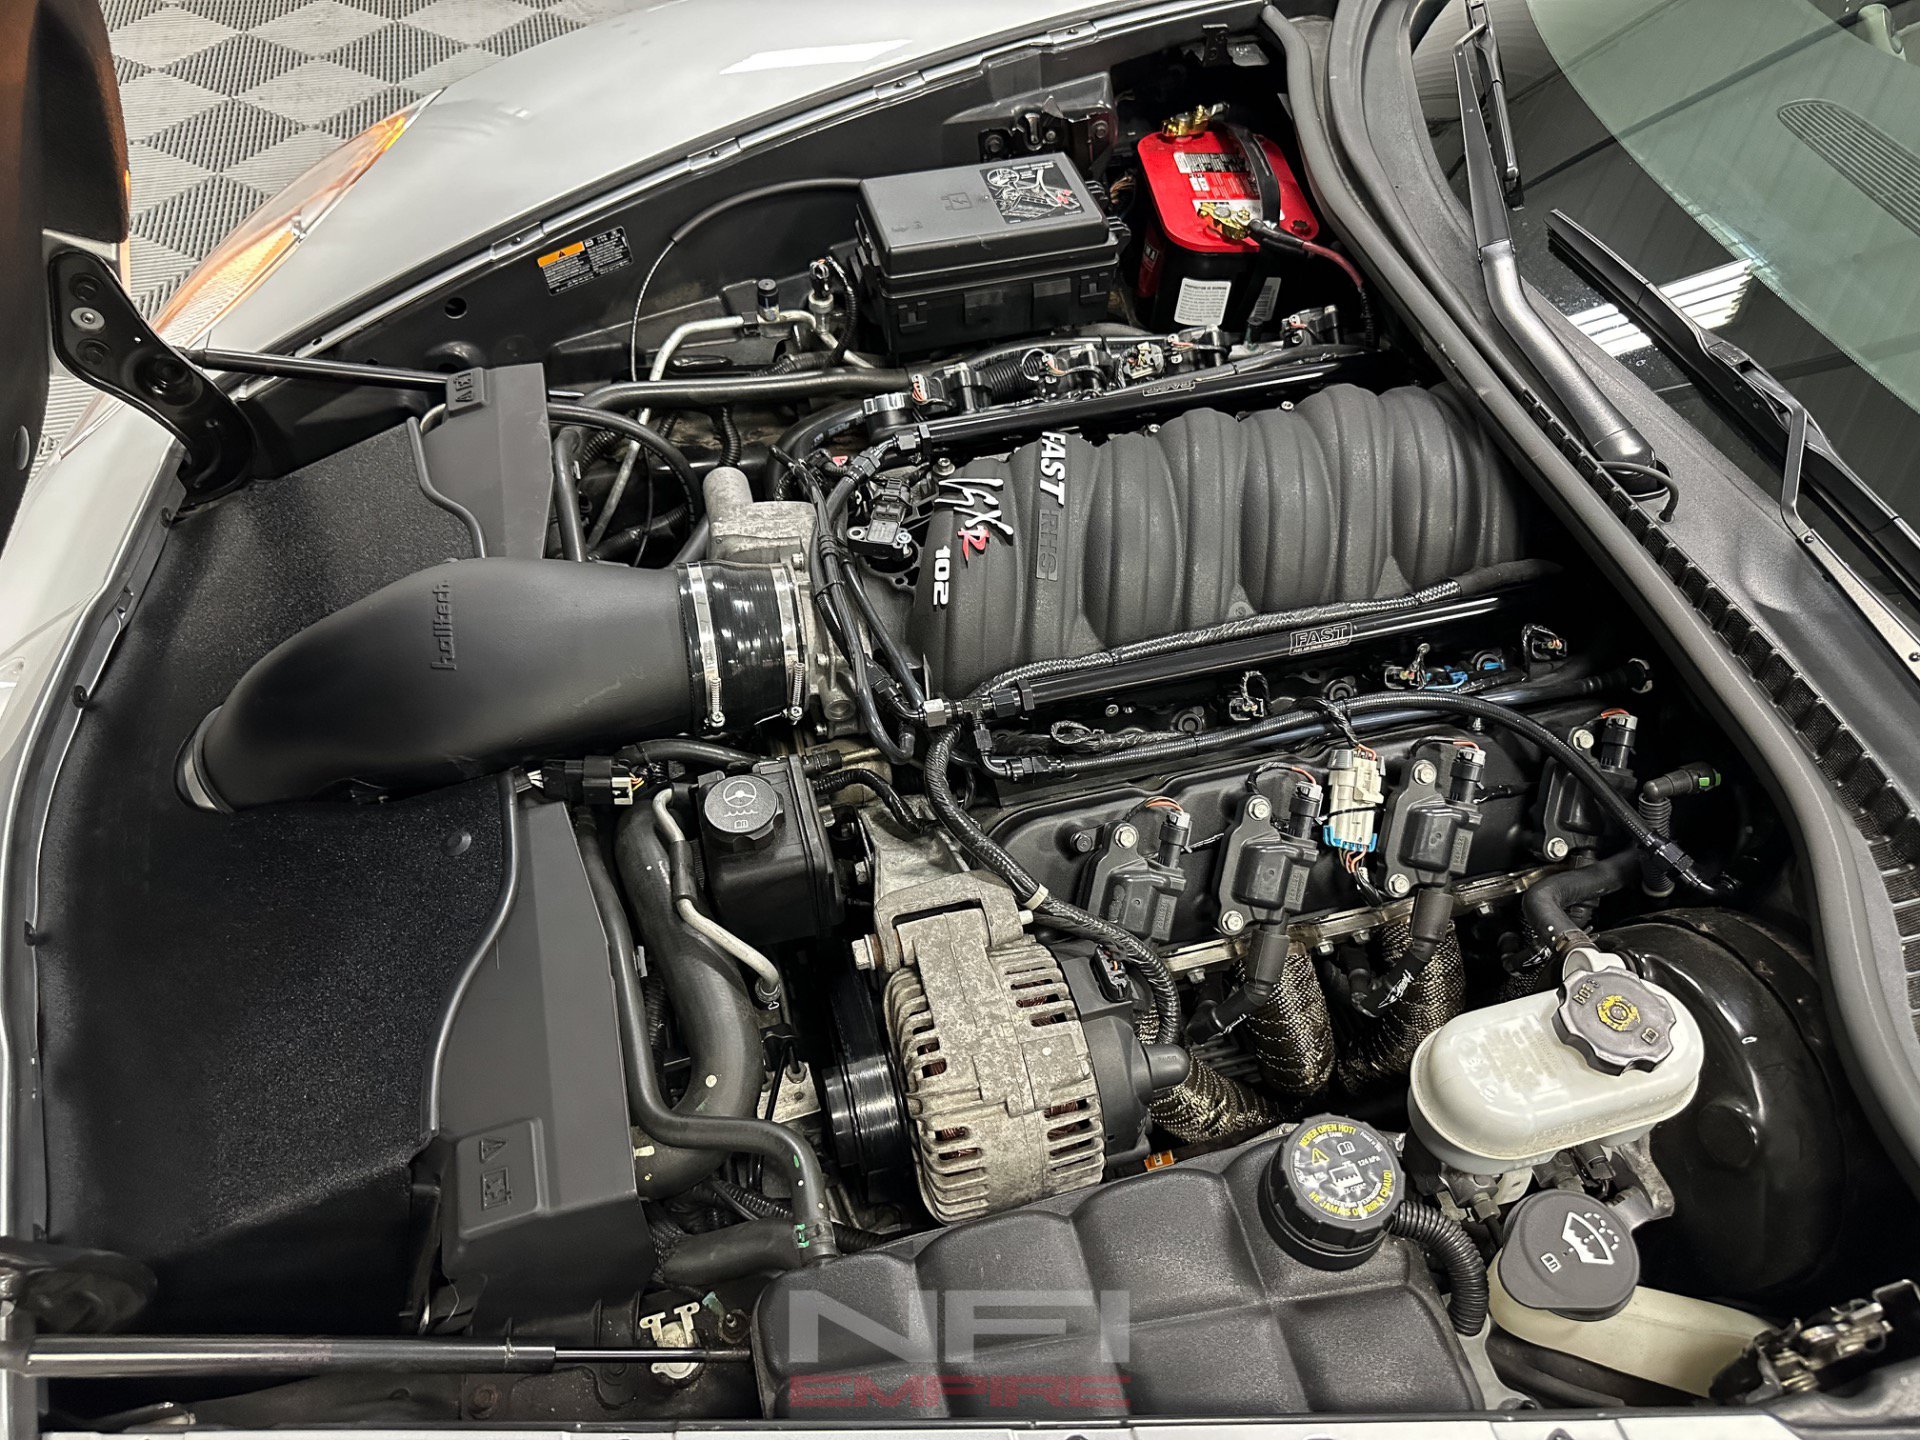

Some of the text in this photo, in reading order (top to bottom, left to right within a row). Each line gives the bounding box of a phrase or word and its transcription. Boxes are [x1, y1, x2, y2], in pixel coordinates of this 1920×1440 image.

[1040, 431, 1066, 506] FAST
[1038, 509, 1060, 580] RHS
[933, 545, 951, 606] 102
[1295, 624, 1348, 648] FAST
[1572, 983, 1594, 1006] DOT
[1299, 1123, 1357, 1148] NEVER OPEN HOT!
[1357, 1155, 1381, 1167] 124 kPa
[1308, 1191, 1320, 1203] NE
[1319, 1200, 1351, 1217] JAMAIS
